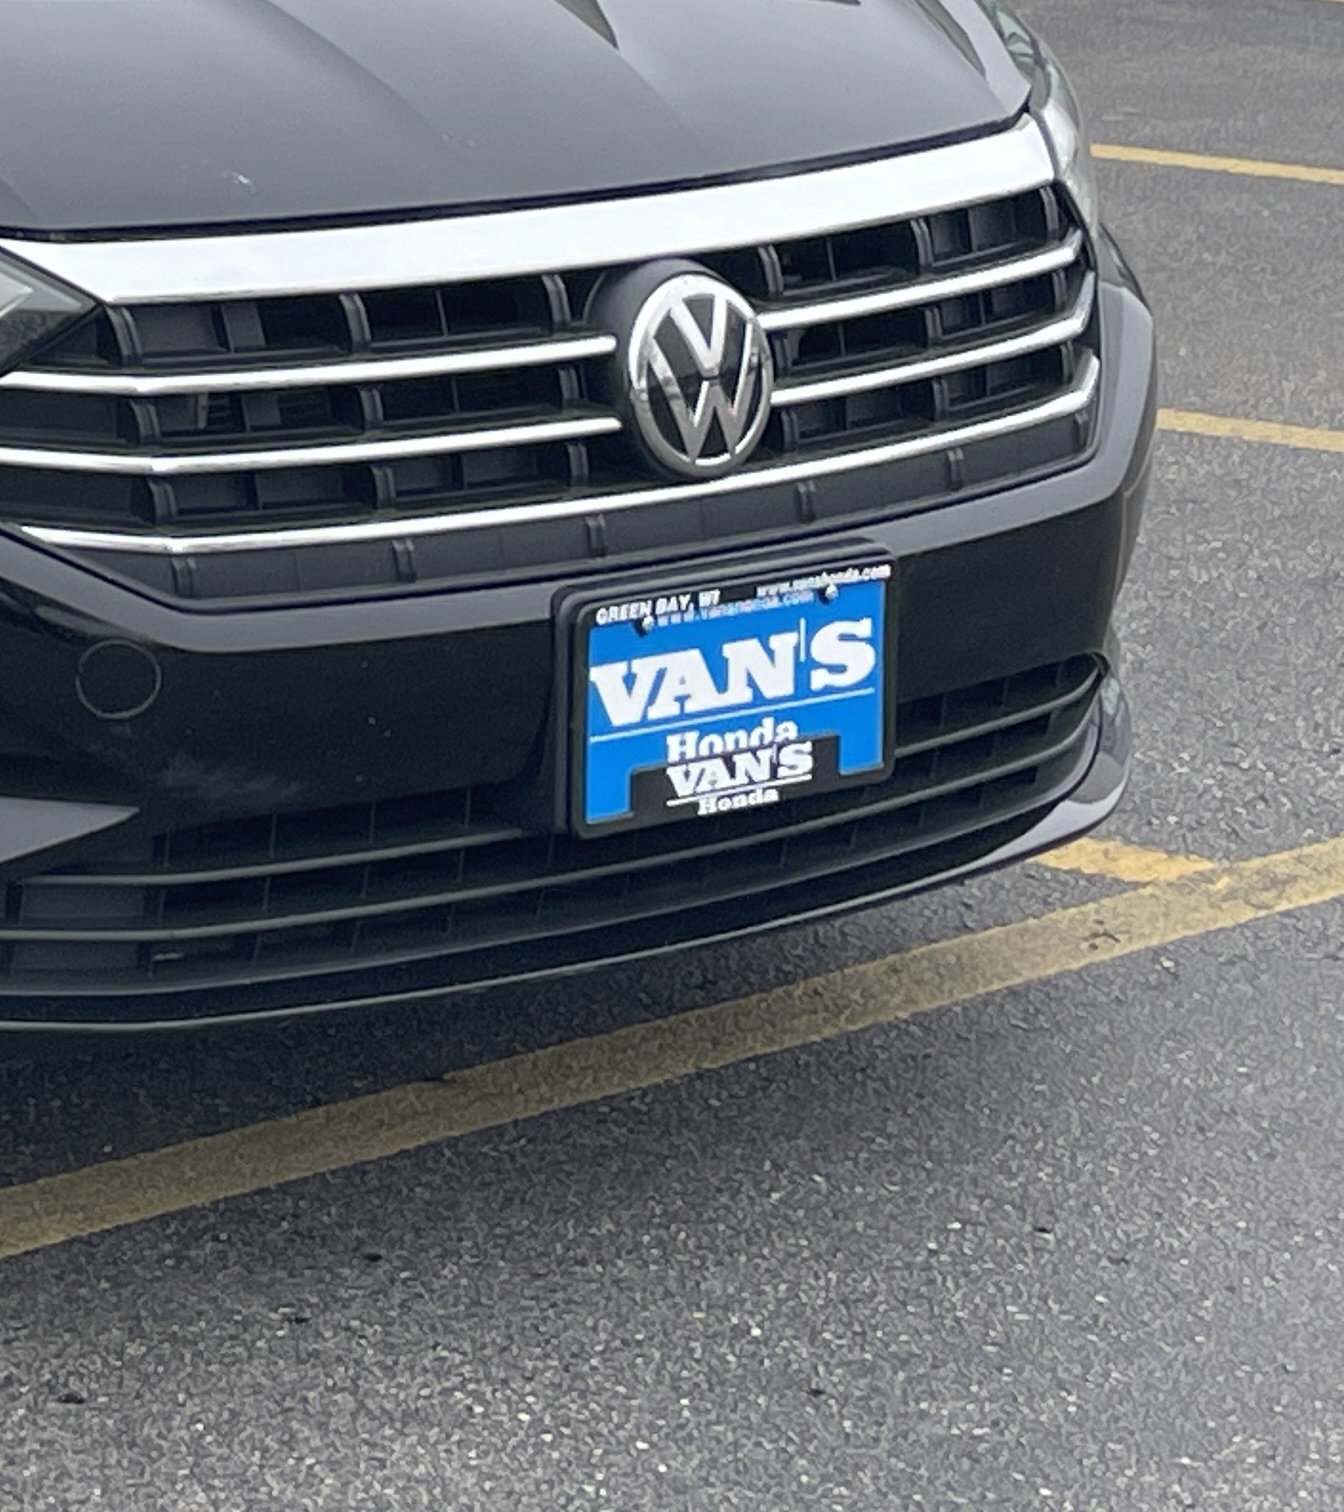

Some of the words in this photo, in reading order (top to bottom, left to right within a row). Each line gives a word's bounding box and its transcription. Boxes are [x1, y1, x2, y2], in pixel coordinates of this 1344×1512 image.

[596, 600, 652, 626] GREEN
[589, 617, 876, 727] VAN'S
[666, 716, 799, 763] Honda
[697, 786, 780, 816] Honda
